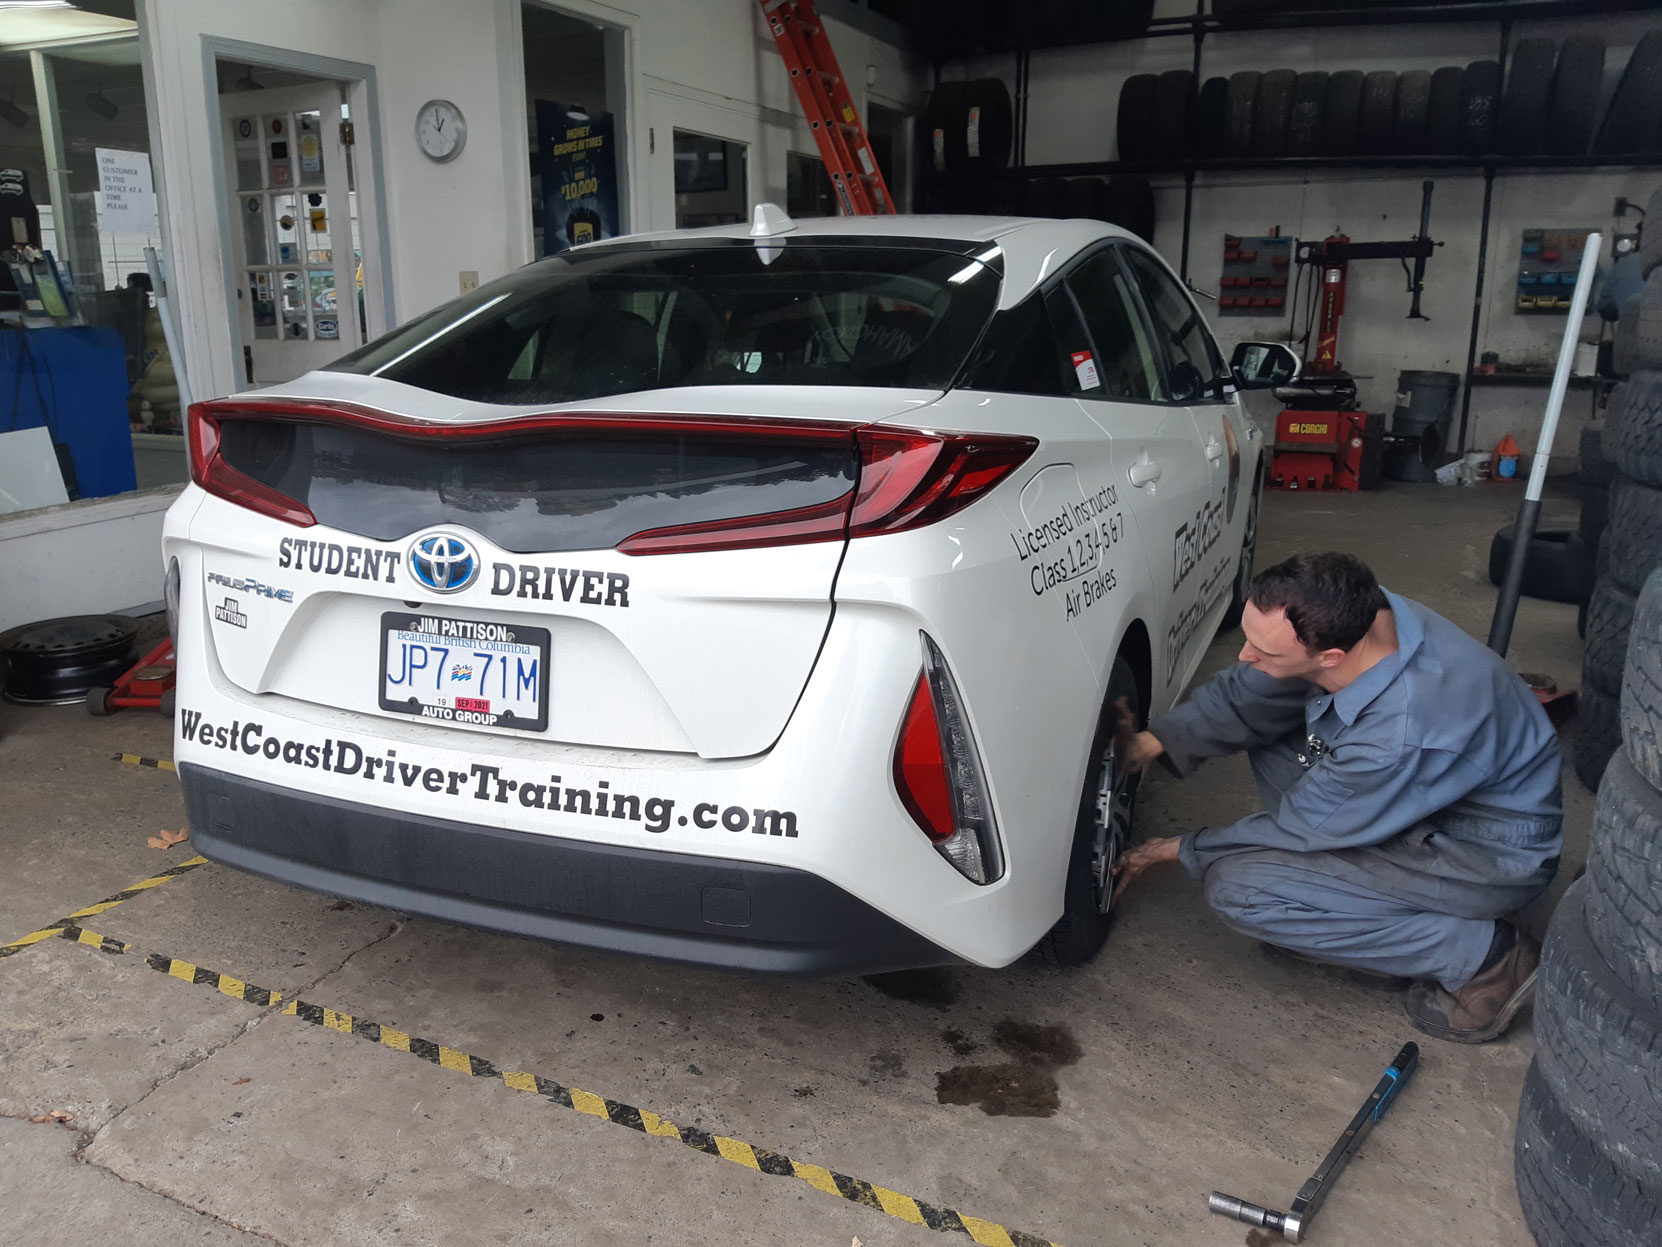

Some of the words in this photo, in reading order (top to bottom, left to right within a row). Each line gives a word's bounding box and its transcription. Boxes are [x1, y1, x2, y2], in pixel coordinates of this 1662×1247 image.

[103, 167, 138, 175] CUSTOMER
[112, 176, 125, 184] THE
[105, 185, 126, 193] OFFICE
[561, 177, 598, 200] $10,000
[1300, 423, 1328, 435] CORGHI
[1010, 501, 1074, 561] Licensed
[1067, 484, 1119, 528] Instructor
[1031, 558, 1068, 596] Class
[1116, 511, 1124, 538] 7
[278, 537, 401, 584] STUDENT
[491, 562, 630, 608] DRIVER
[225, 599, 238, 613] JIM
[1066, 588, 1081, 622] Air
[1082, 568, 1117, 608] Brakes
[215, 607, 247, 628] PATTISON
[417, 617, 439, 635] JIM
[441, 620, 507, 642] PATTISON
[397, 630, 441, 645] Beautiful
[444, 637, 477, 649] British
[478, 640, 531, 655] Columbia
[387, 643, 450, 690] JP7
[473, 652, 538, 703] 71M
[437, 698, 447, 706] 19
[457, 698, 470, 708] SEP
[474, 700, 489, 711] 2021
[421, 705, 454, 720] AUTO
[455, 710, 498, 726] GROUP
[180, 708, 799, 838] WestCoastDriverTraining.com
